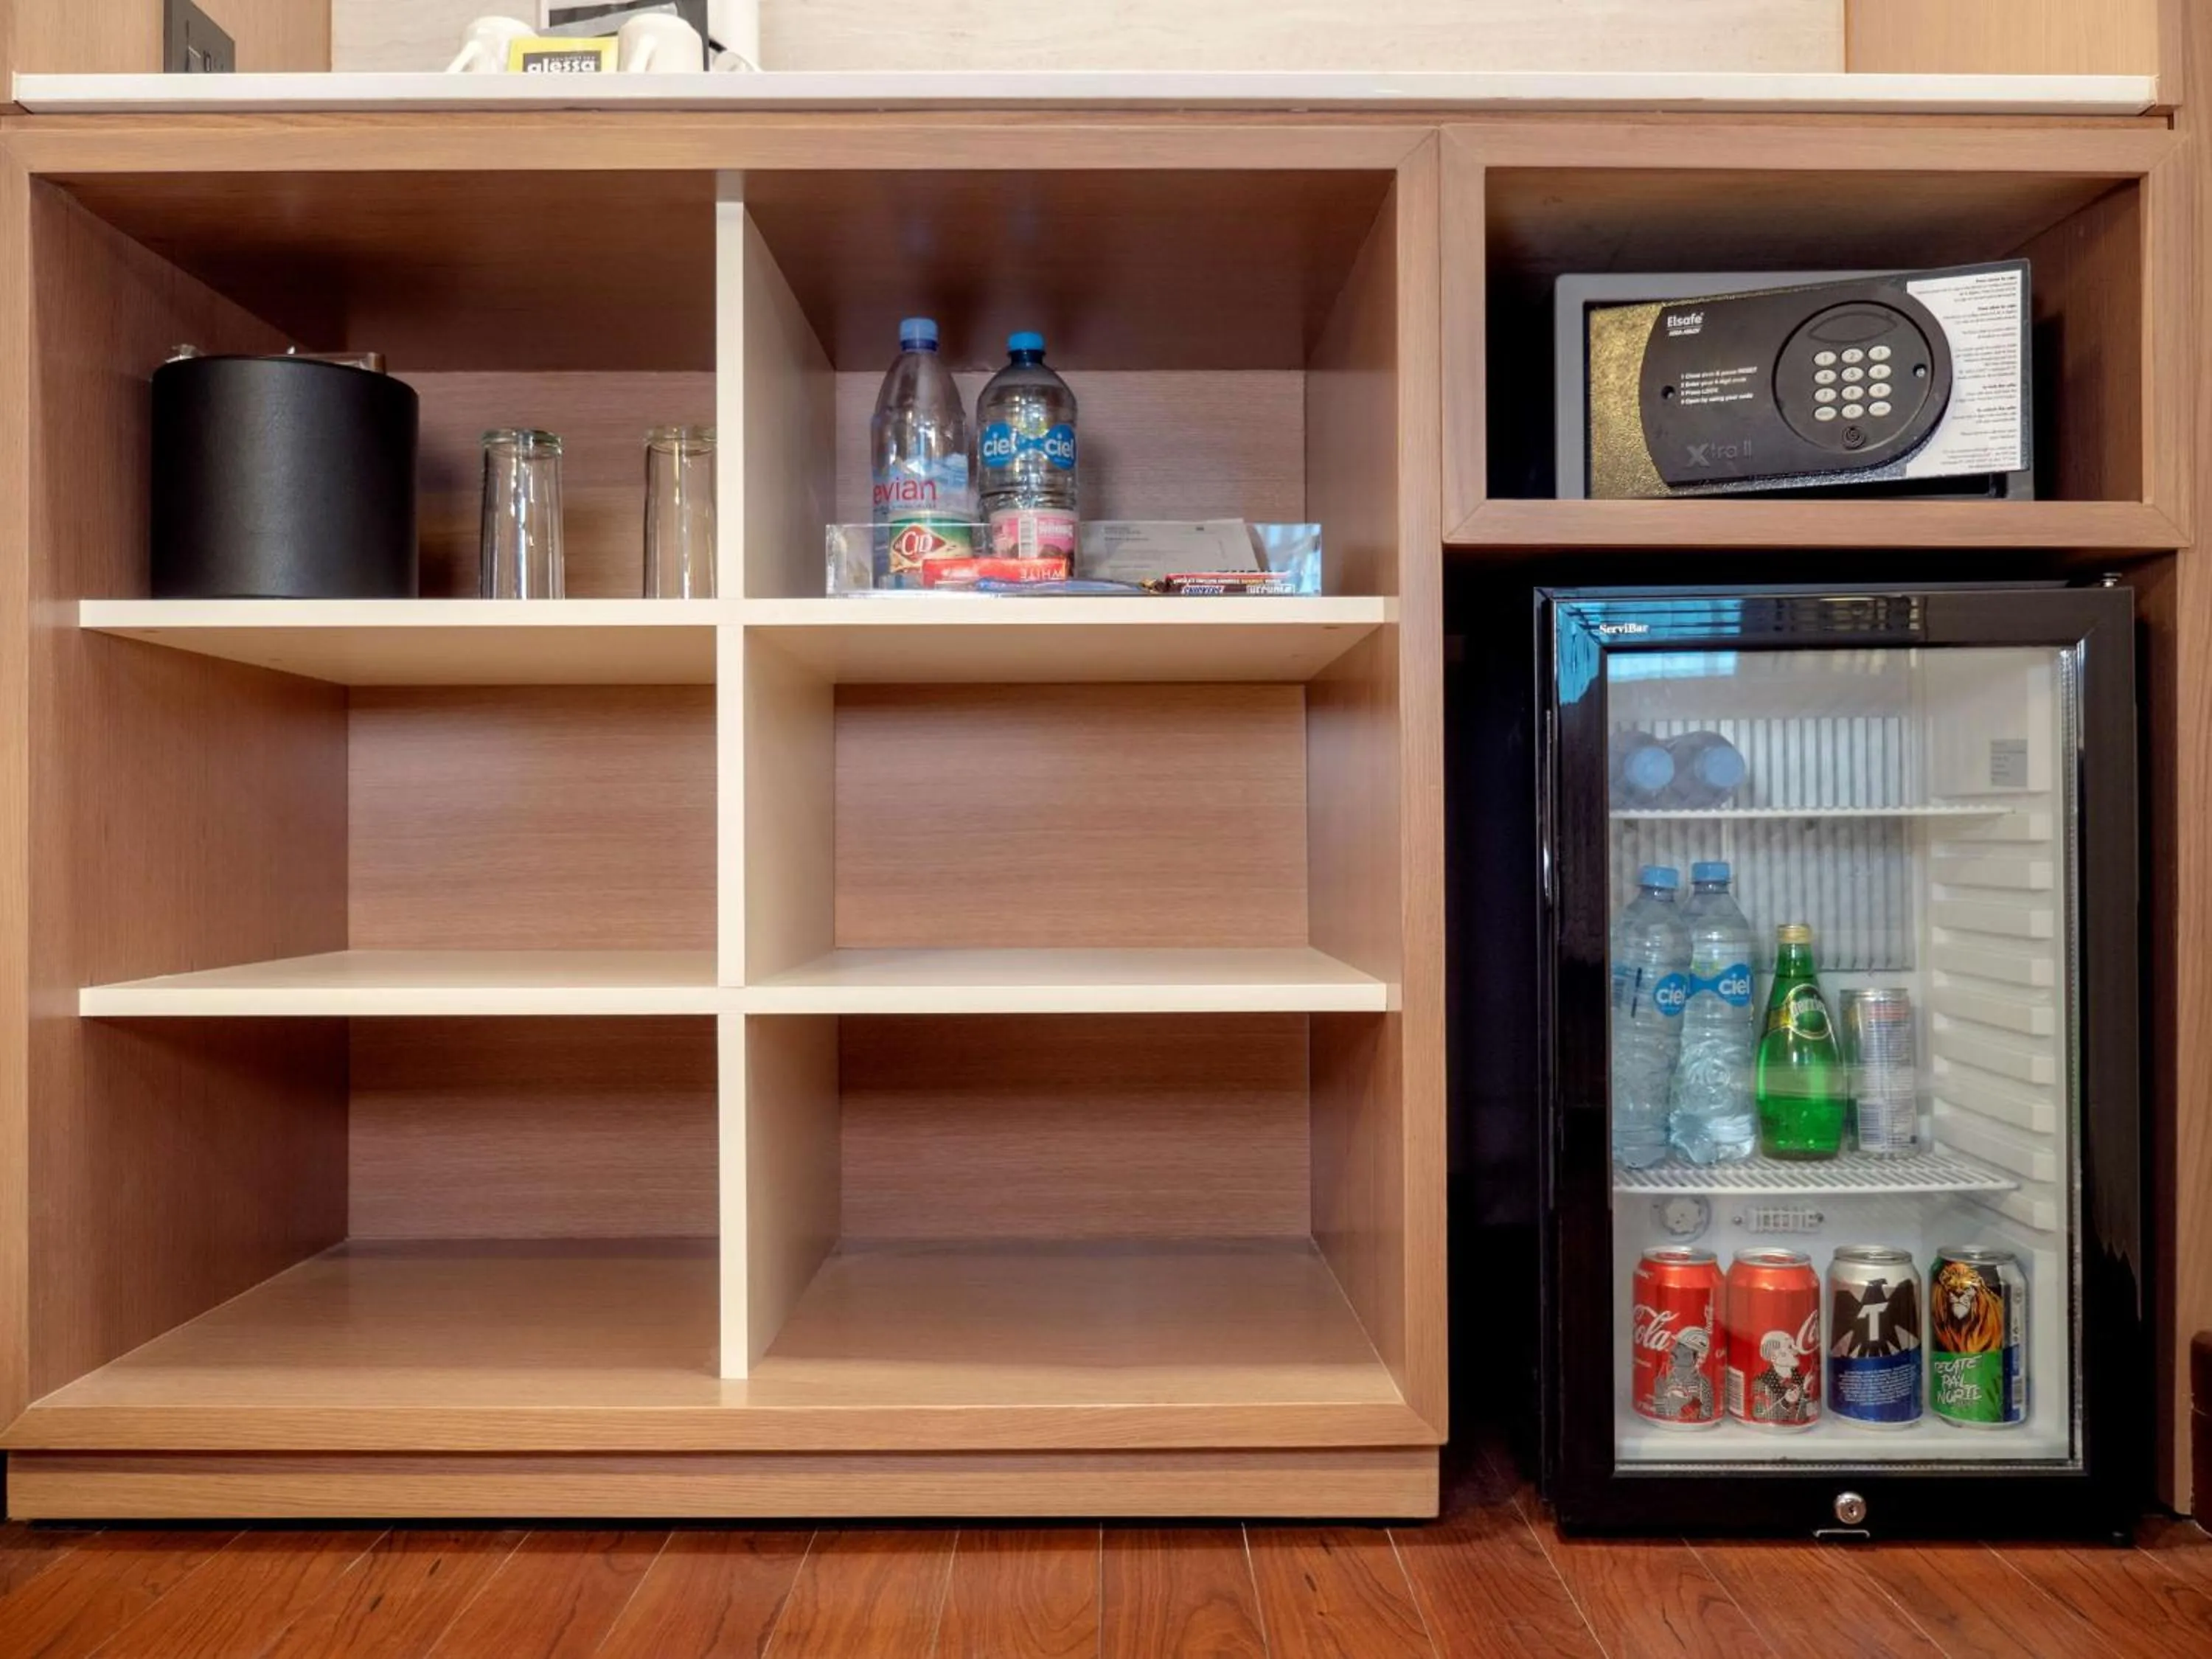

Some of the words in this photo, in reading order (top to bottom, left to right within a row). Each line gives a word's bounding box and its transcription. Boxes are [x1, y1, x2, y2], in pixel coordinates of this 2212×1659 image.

[983, 428, 1018, 456] ciel
[1045, 433, 1074, 459] ciel
[873, 477, 936, 506] evian
[1599, 623, 1649, 633] ServiBar
[1656, 982, 1686, 1005] ciel
[1718, 973, 1751, 996] ciel
[1857, 1302, 1889, 1341] T
